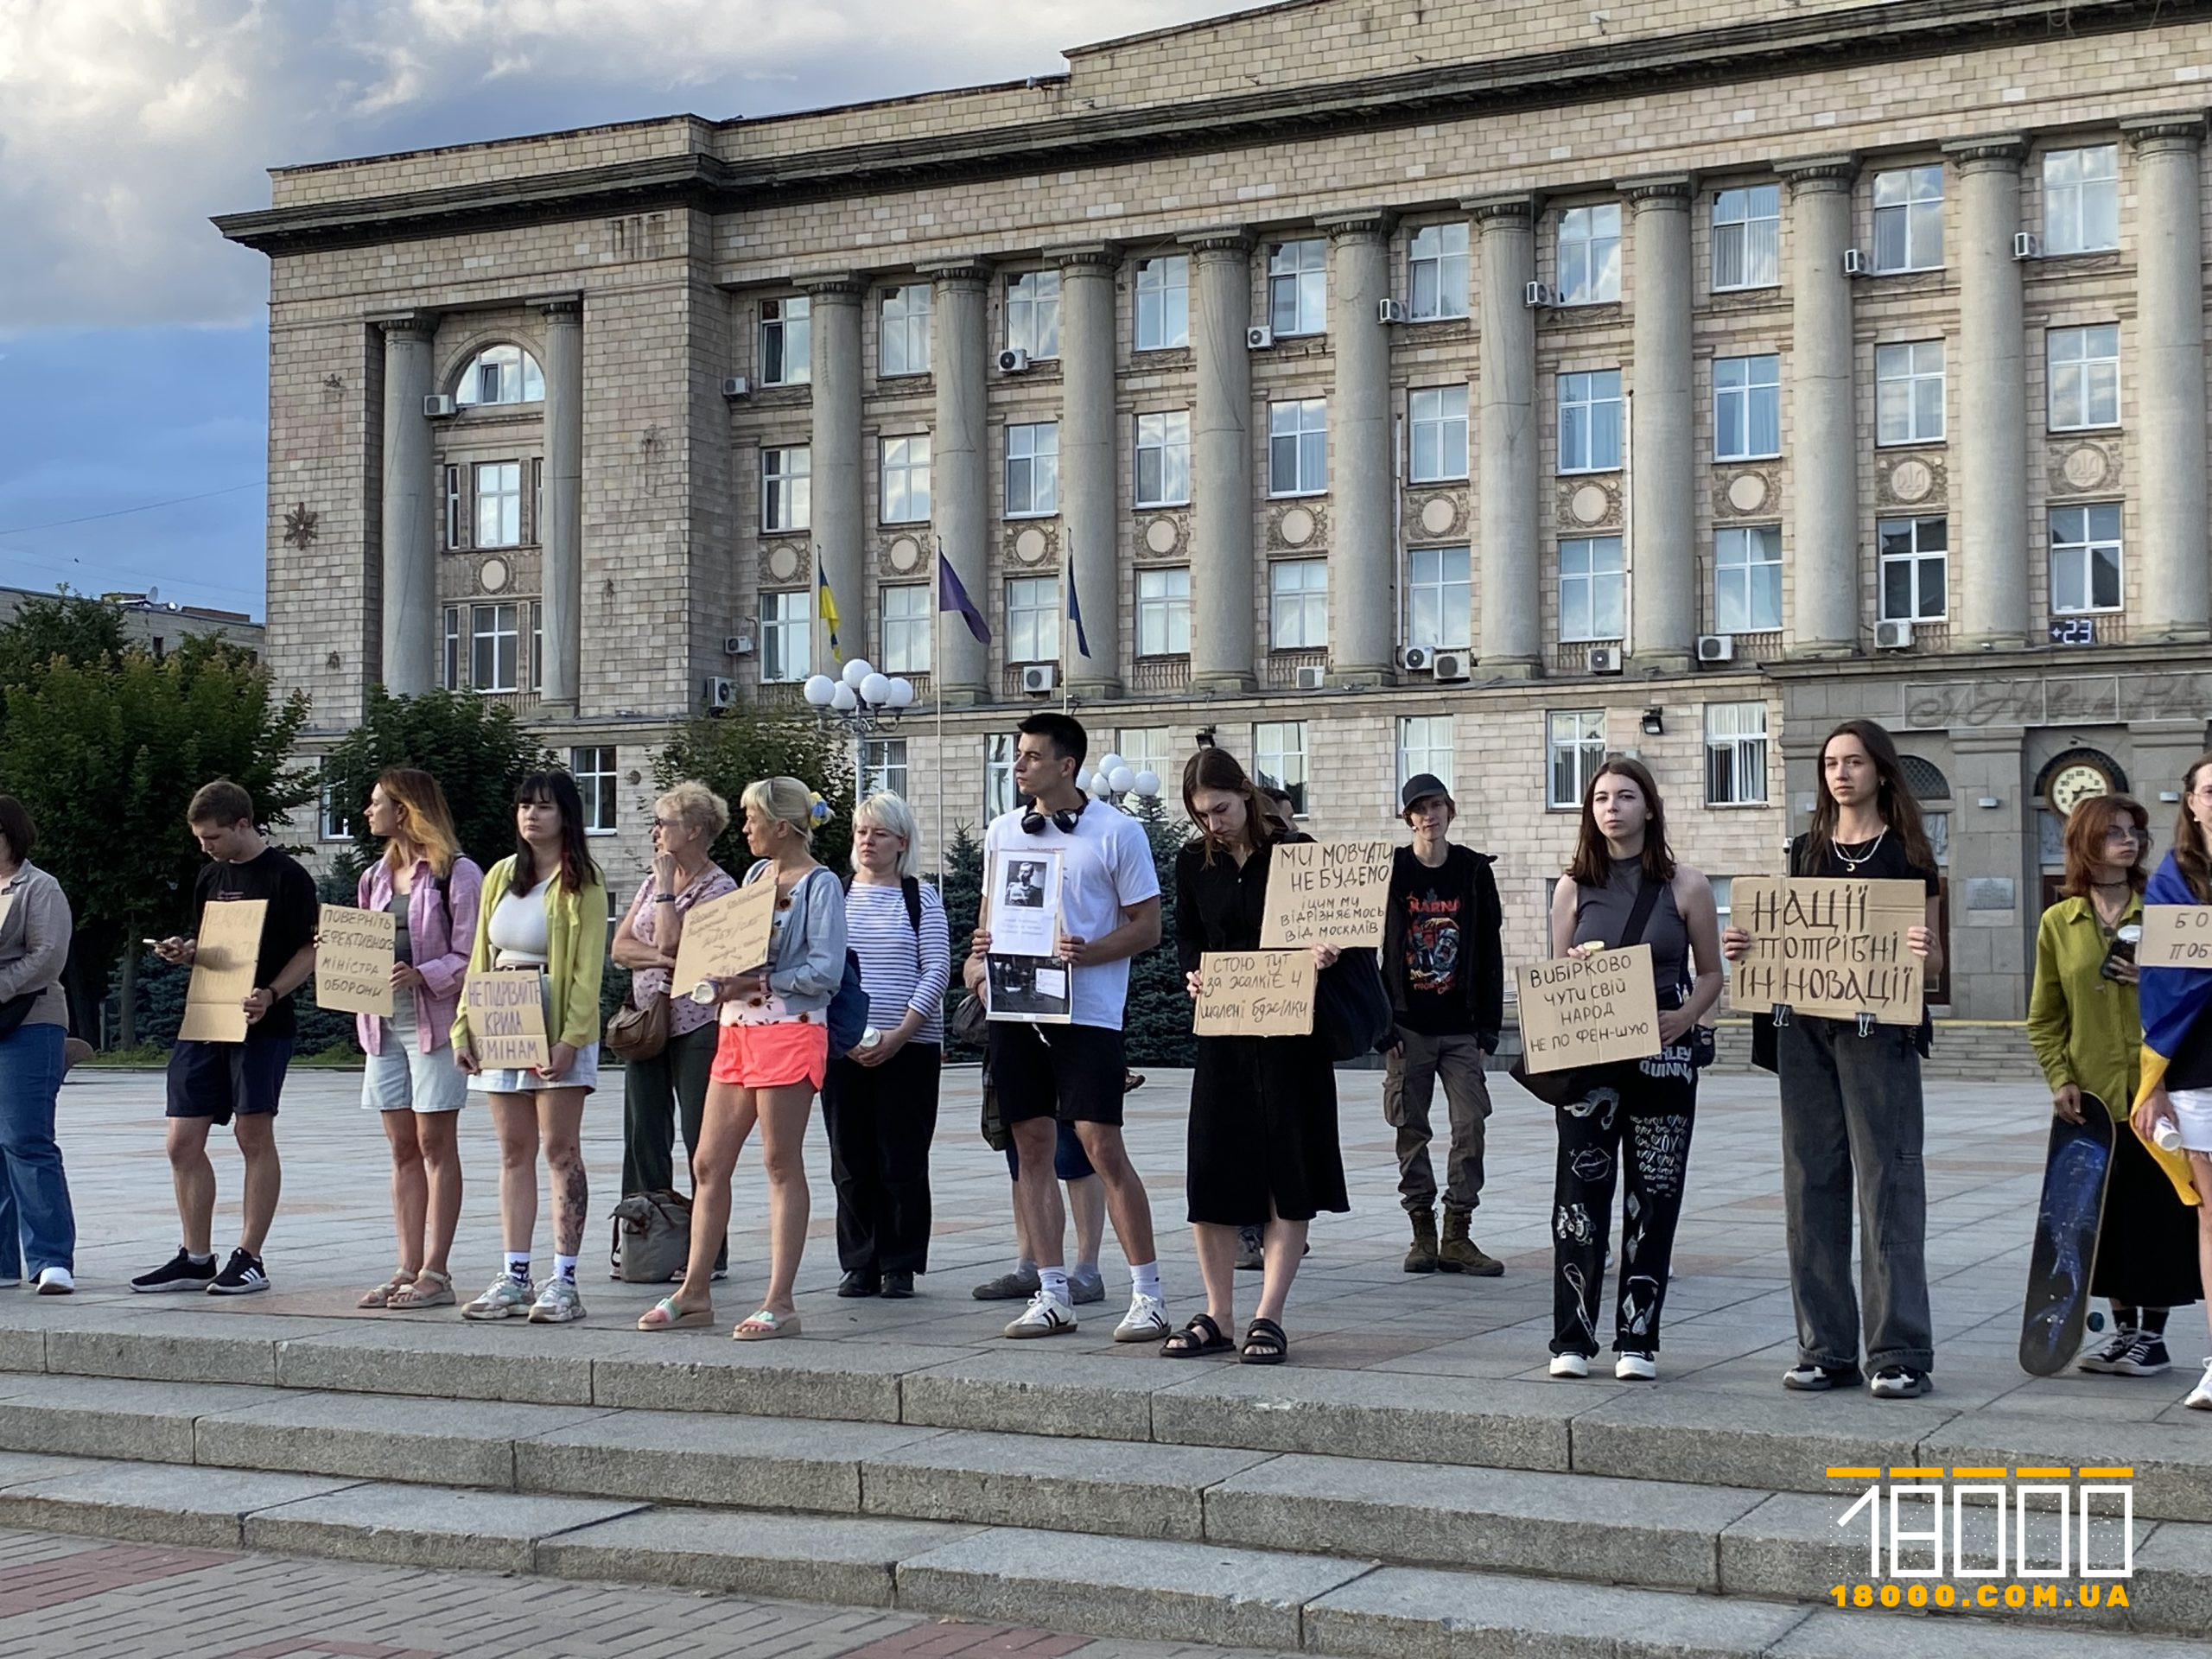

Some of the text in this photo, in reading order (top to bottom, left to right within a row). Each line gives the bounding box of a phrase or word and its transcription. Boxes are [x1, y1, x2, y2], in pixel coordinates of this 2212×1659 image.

[2050, 620, 2092, 644] +23
[1281, 842, 1394, 868] МИ МОВЧАТИ
[1319, 865, 1389, 890] БУДЕМО
[324, 910, 391, 930] ПОВЕРНІТЬ
[1751, 884, 1868, 934] НАЦІЇ
[1758, 931, 1898, 963] ПОТРІБНІ
[322, 957, 379, 975] МІНІСТРА
[1213, 957, 1255, 973] СТОЮ
[1530, 955, 1631, 988] ВИБІРКОВО
[324, 979, 384, 997] ОБОРОНИ
[468, 981, 482, 1007] НЕ
[1544, 978, 1626, 1007] ЧУТИ СВІЙ
[1740, 960, 1913, 1008] ІННОВАЦІЇ
[1560, 1002, 1615, 1026] НАРОД
[1530, 1022, 1649, 1052] НЕ ПО ФЕН-ШУЮ
